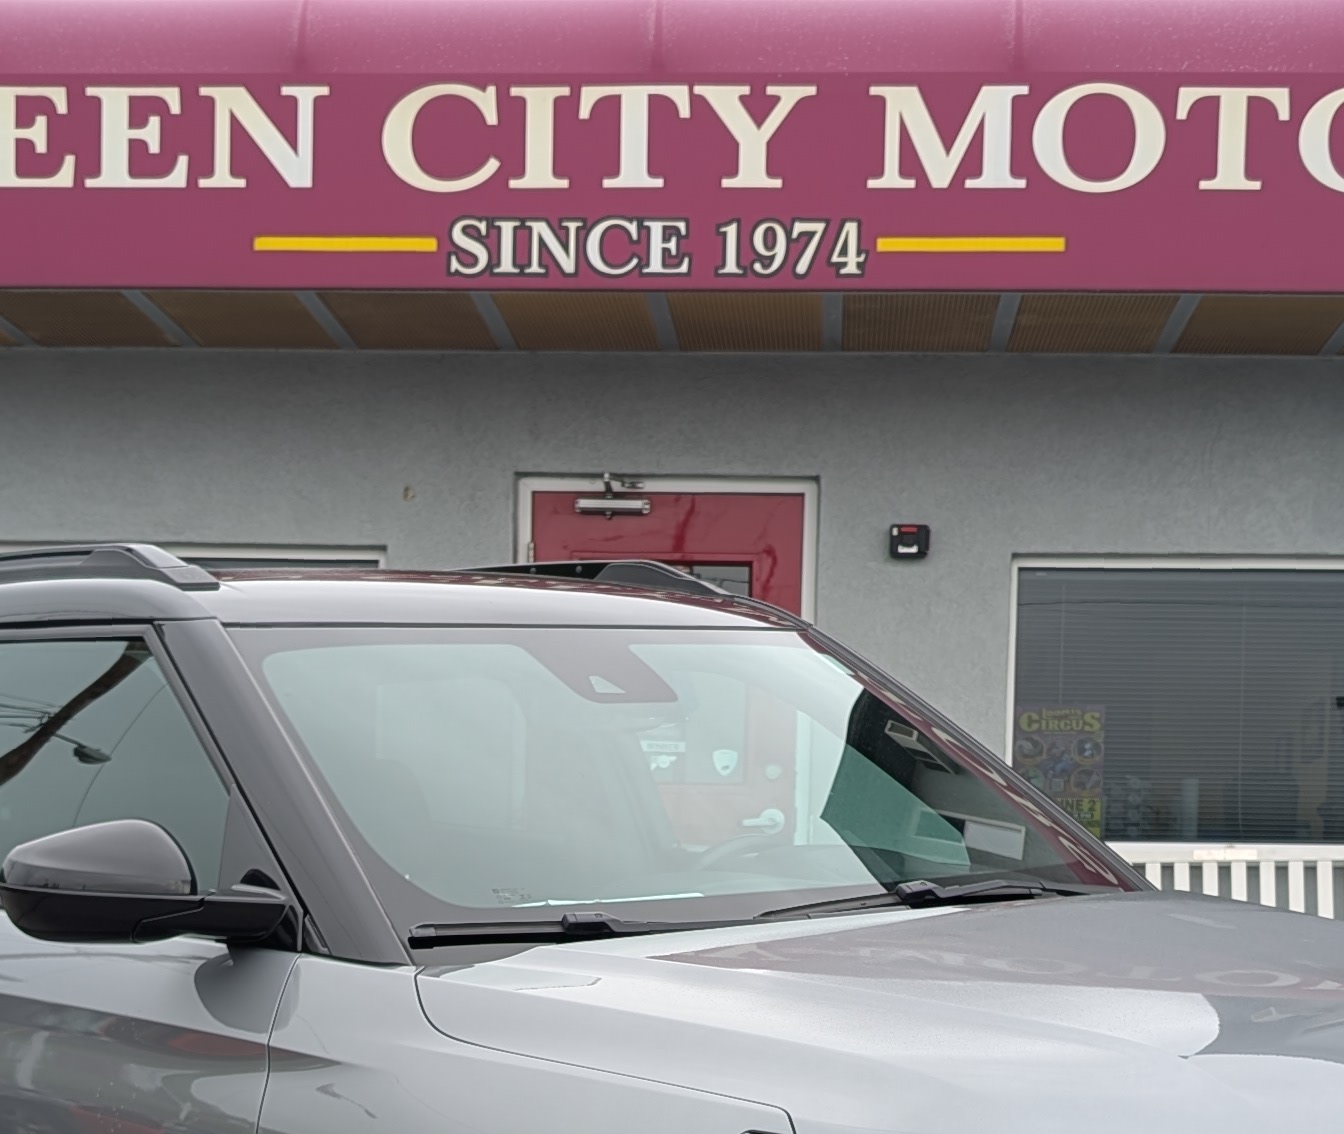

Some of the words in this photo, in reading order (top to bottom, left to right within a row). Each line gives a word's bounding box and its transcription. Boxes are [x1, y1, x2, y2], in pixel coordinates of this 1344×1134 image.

[380, 83, 818, 193] CITY
[449, 217, 692, 278] SINCE
[716, 219, 867, 278] 1974
[1019, 712, 1101, 732] CIRCUS
